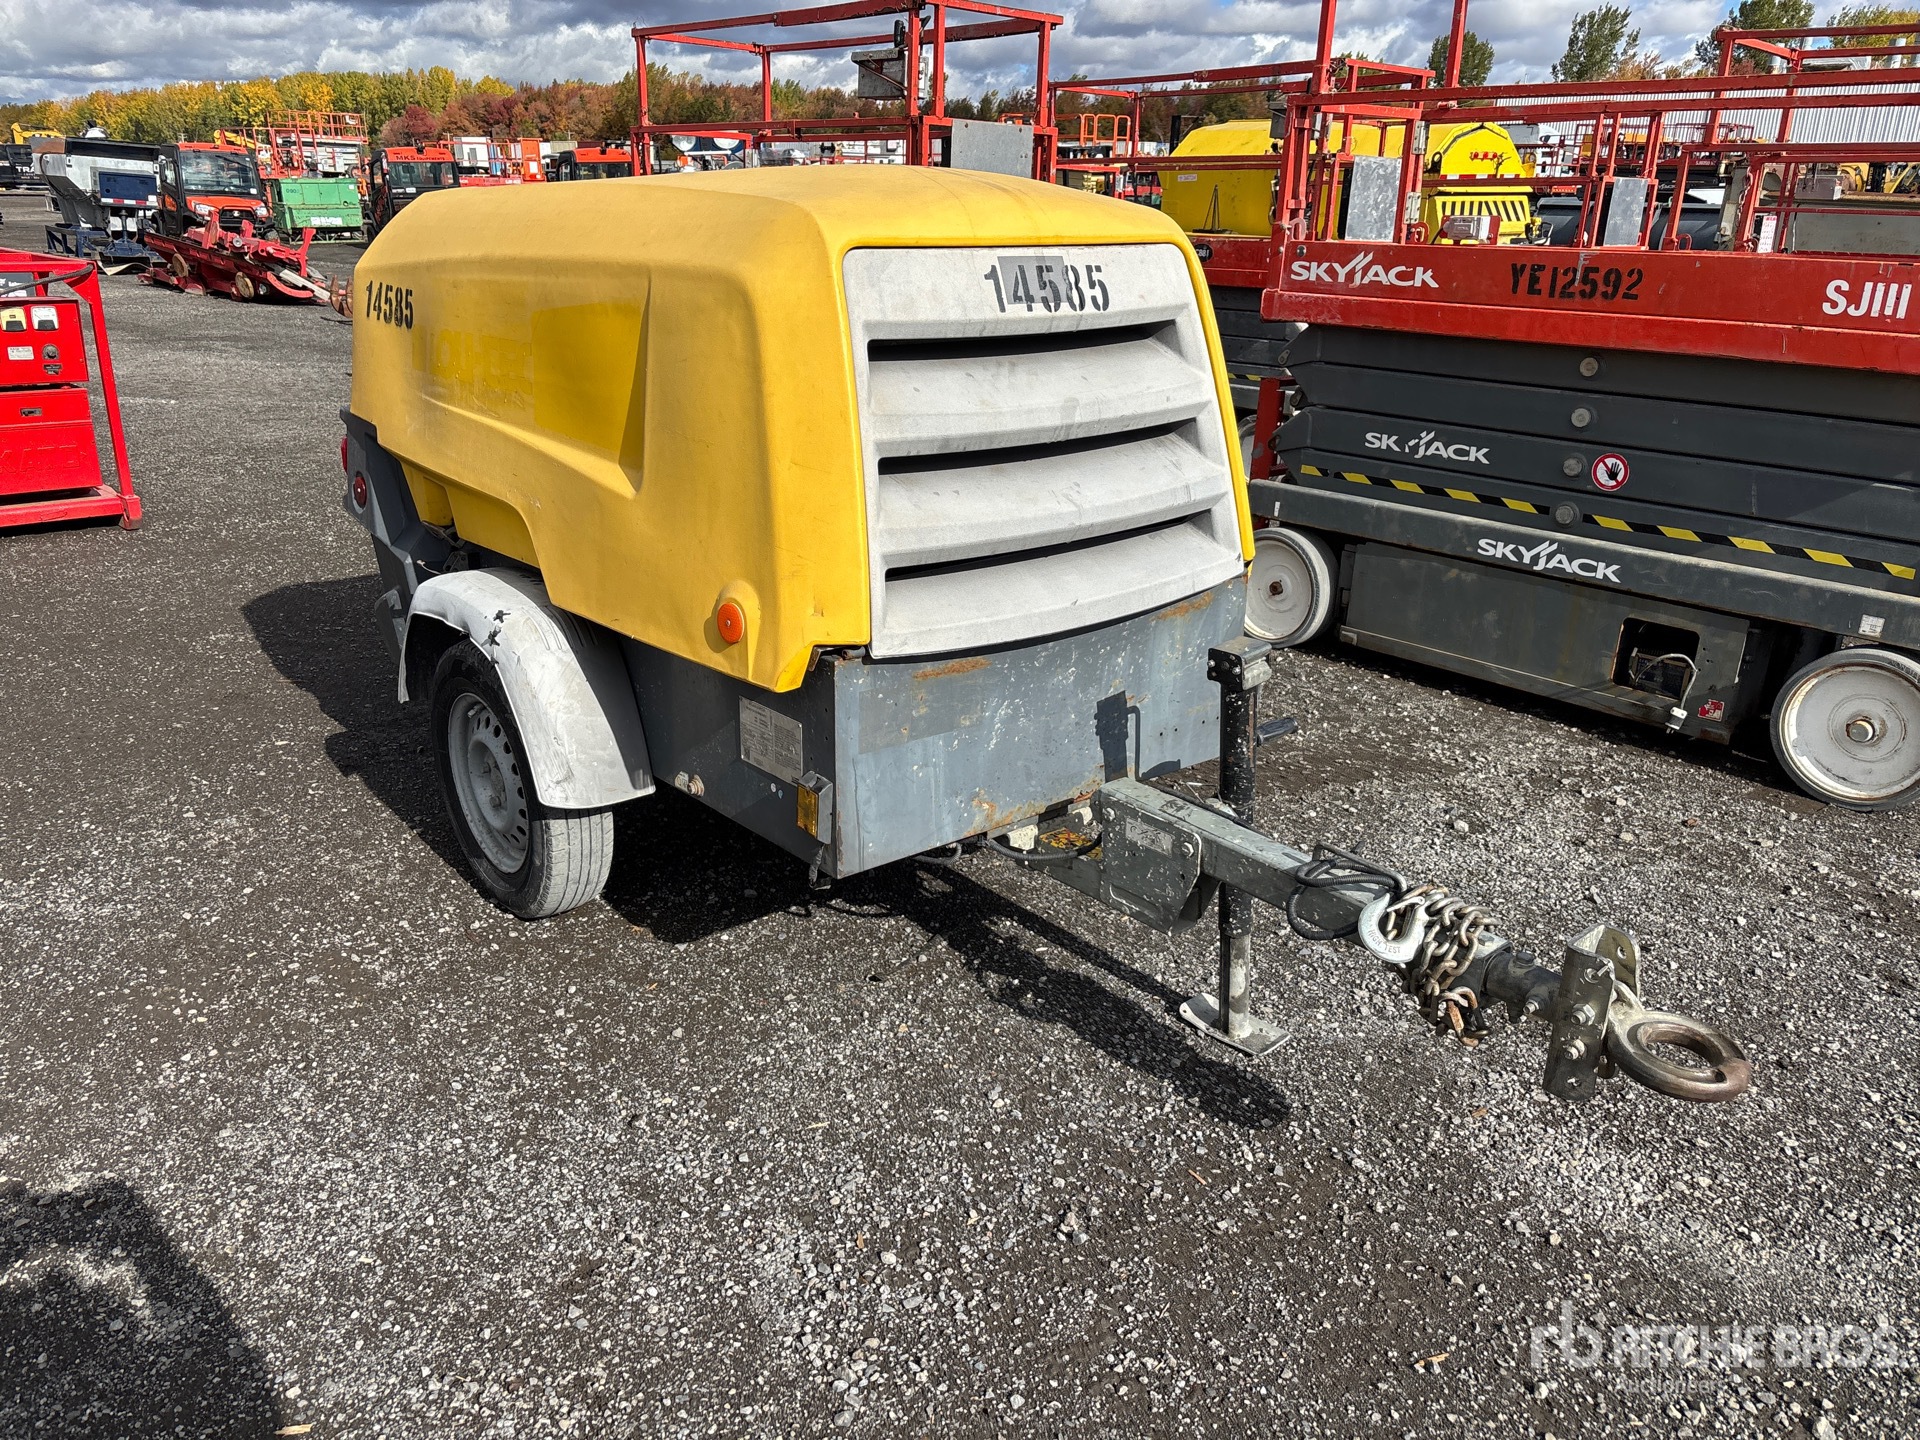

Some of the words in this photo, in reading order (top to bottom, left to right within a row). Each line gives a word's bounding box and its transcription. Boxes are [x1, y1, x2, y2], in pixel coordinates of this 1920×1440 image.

[982, 264, 1110, 313] 14585
[1290, 250, 1440, 289] SKYJACK
[1510, 262, 1644, 301] YE12592
[365, 279, 414, 330] 14585
[1822, 279, 1913, 320] SJIII
[1477, 539, 1622, 583] SKYJACK
